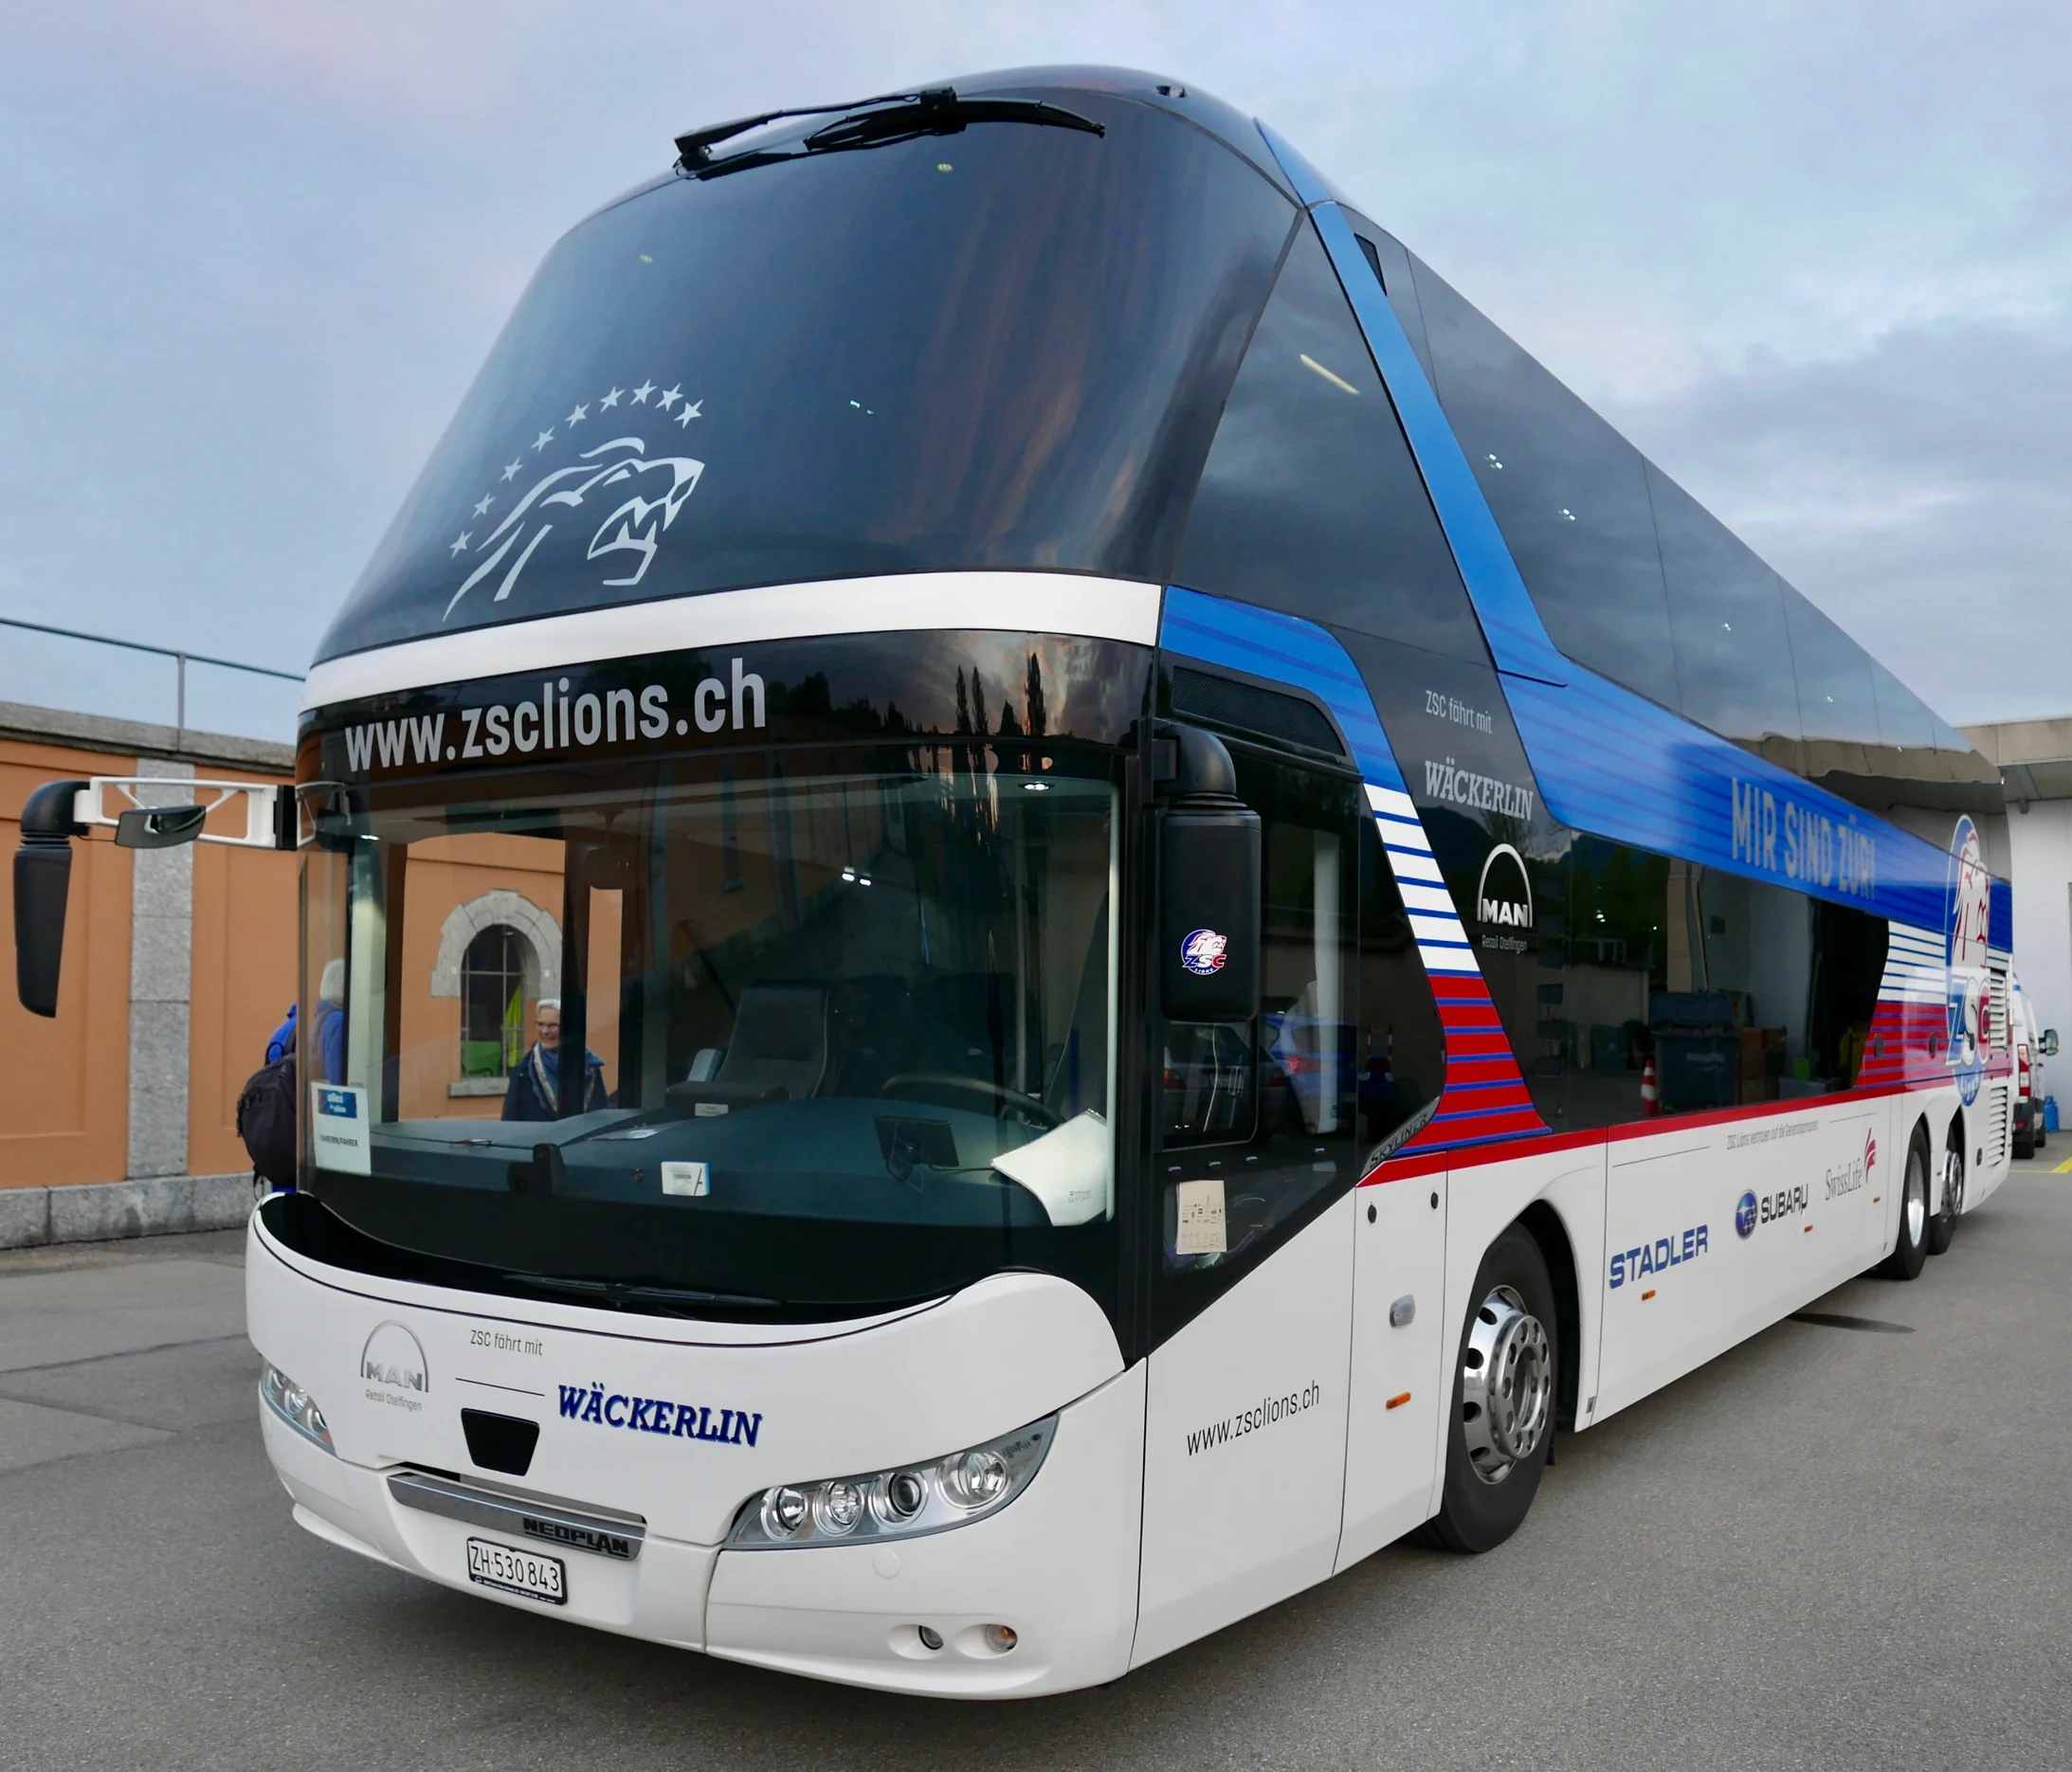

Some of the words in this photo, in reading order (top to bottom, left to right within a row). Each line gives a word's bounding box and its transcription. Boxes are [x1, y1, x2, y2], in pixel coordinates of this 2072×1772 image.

[345, 658, 766, 772] www.zsclions.ch
[1426, 690, 1446, 718] ZSC
[1448, 697, 1475, 729] fährt
[1477, 711, 1492, 734] mit
[1425, 756, 1534, 821] WÄCKERLIN
[1732, 777, 1776, 872] MIR
[1785, 801, 1832, 888] SIND
[1481, 897, 1528, 928] MAN
[1182, 954, 1227, 967] ZSC
[1370, 1113, 1427, 1168] SKYLINER
[1761, 1184, 1808, 1223] SUBARU
[1609, 1224, 1708, 1289] STADLER
[470, 1329, 492, 1347] ZSC
[494, 1332, 522, 1353] fährt
[524, 1338, 543, 1357] mit
[366, 1360, 423, 1391] MAN
[366, 1388, 385, 1403] Retail
[386, 1393, 423, 1413] Otelfingen
[558, 1382, 763, 1448] WÄCKERLIN
[1187, 1380, 1319, 1456] www.zsclions.ch
[523, 1517, 629, 1558] NEOPLAN
